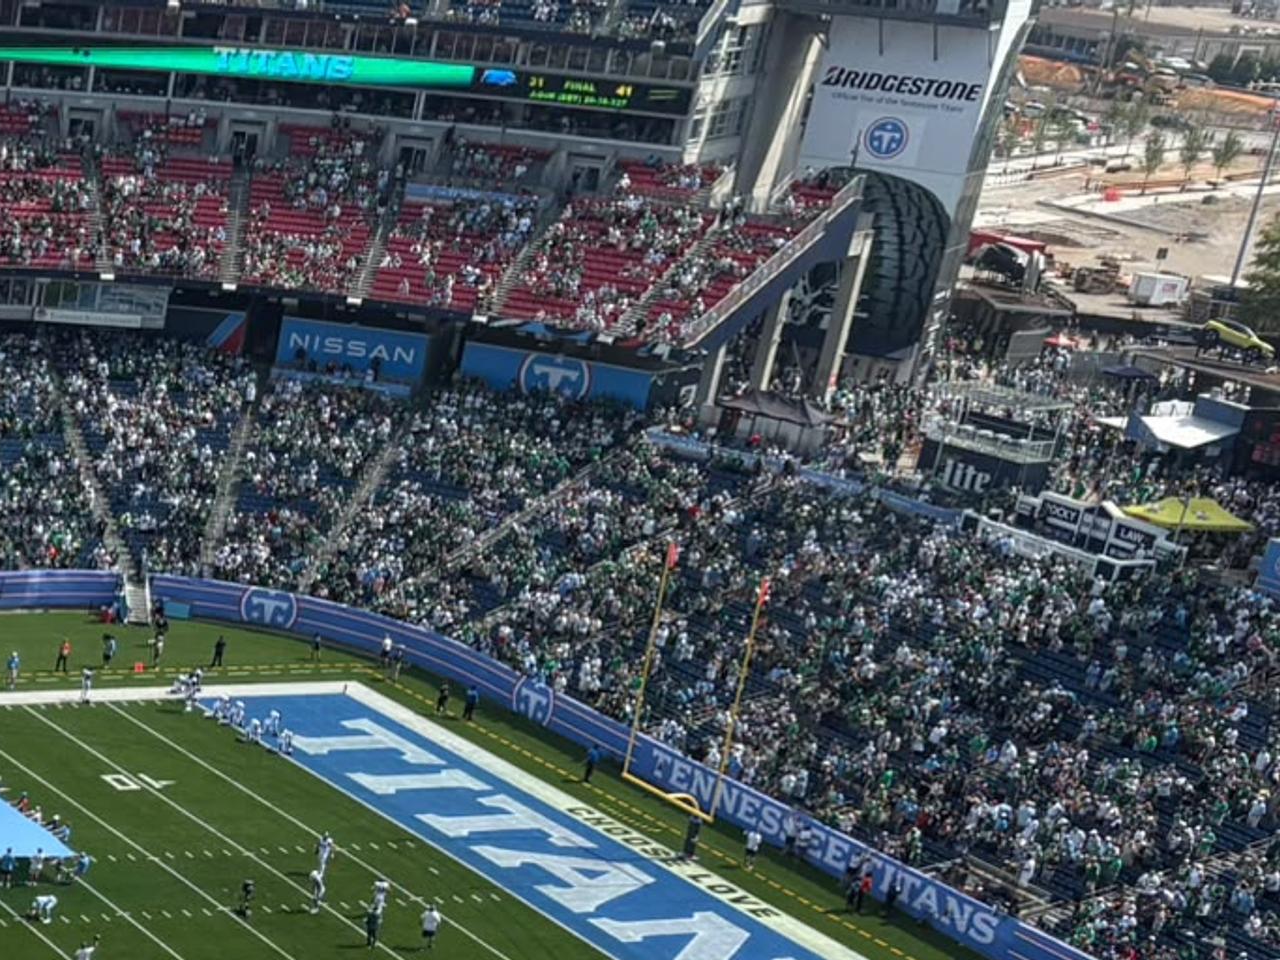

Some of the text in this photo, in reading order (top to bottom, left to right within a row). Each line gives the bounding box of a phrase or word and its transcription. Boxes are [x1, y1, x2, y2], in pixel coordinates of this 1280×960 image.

[213, 47, 354, 80] TITANS
[821, 66, 983, 101] BRIDGESTONE
[289, 331, 415, 365] NISSAN
[652, 746, 854, 872] TENNESEE
[688, 872, 781, 920] LOVE
